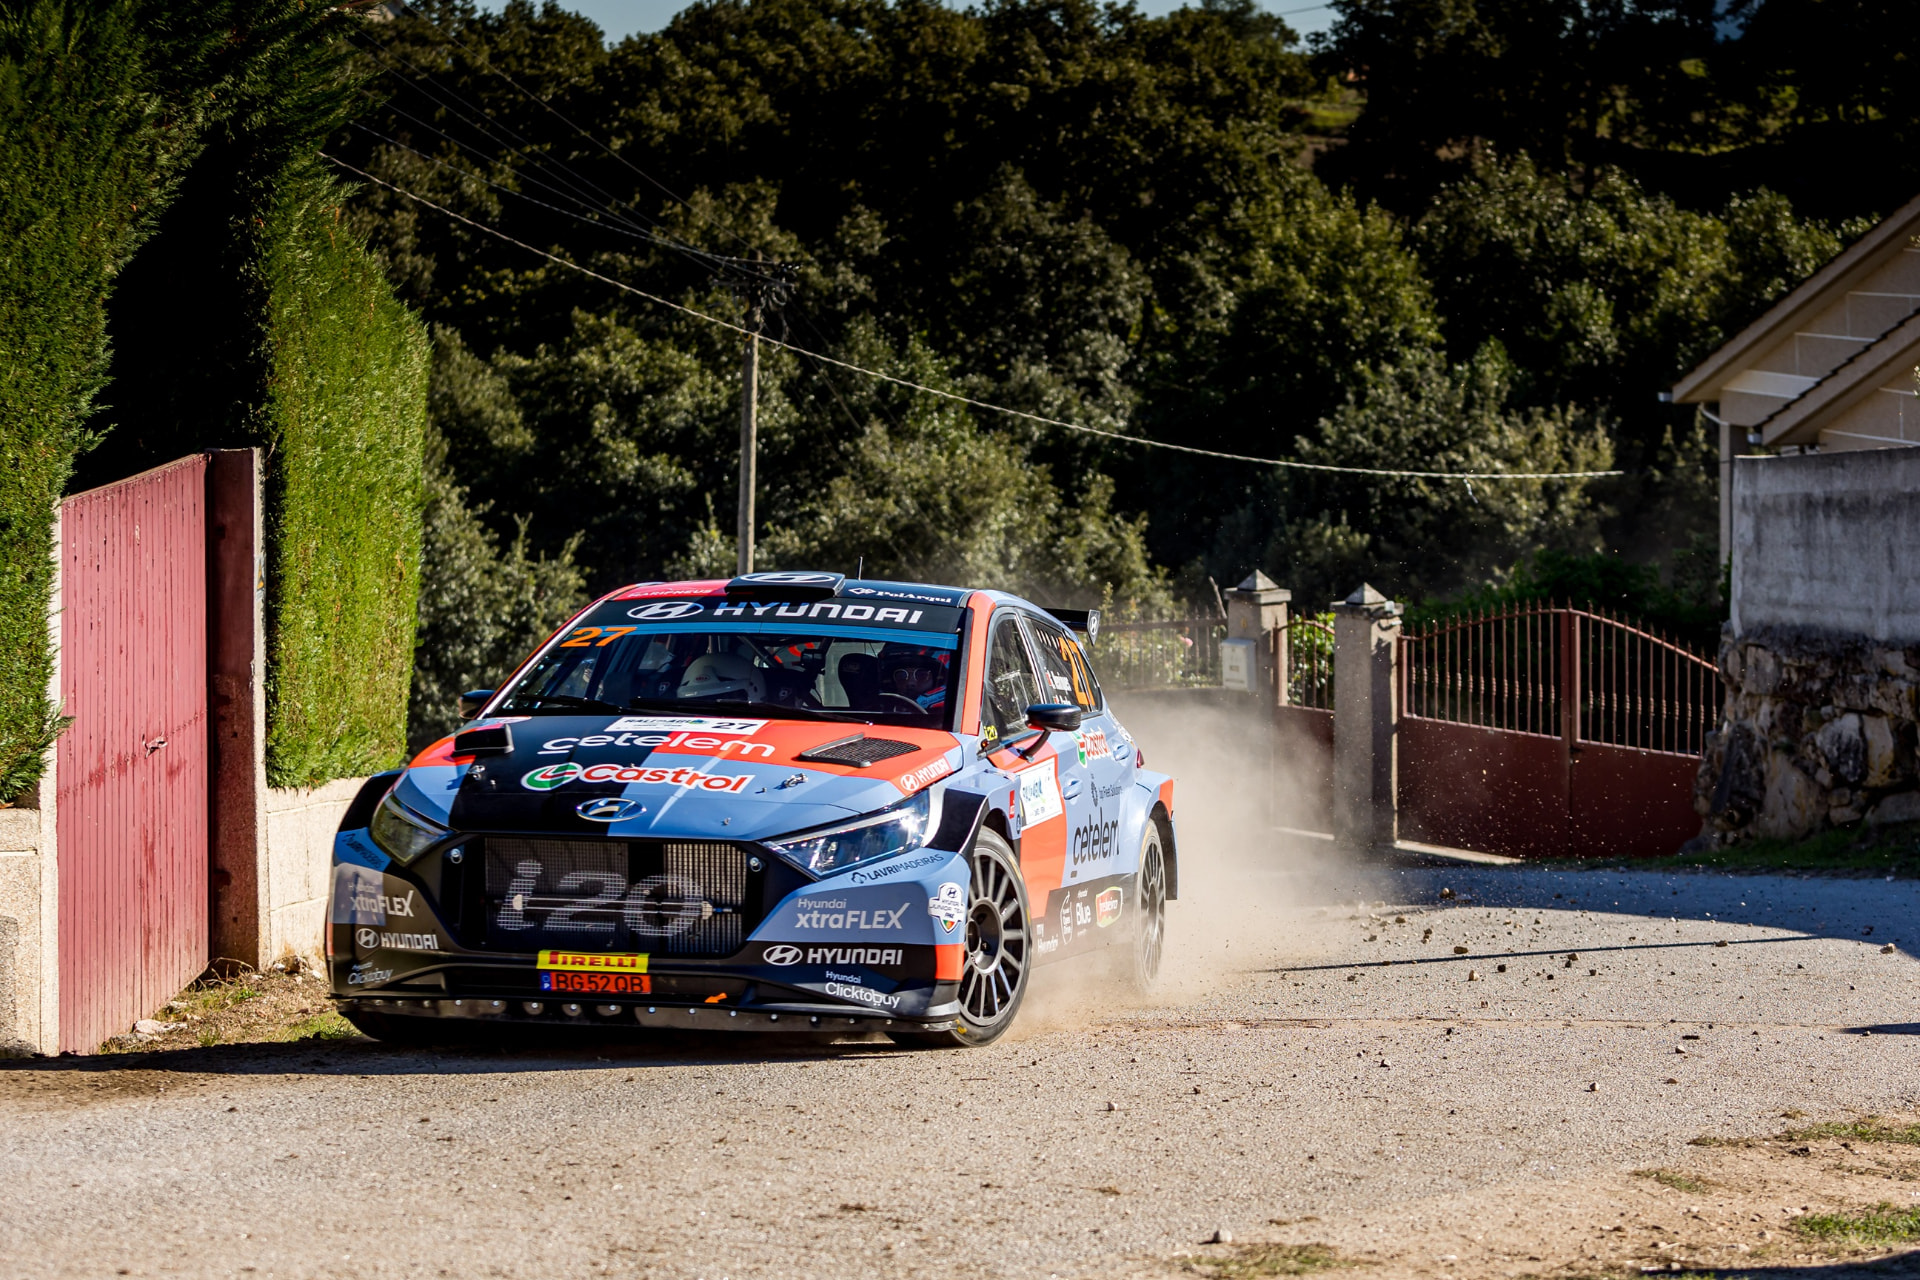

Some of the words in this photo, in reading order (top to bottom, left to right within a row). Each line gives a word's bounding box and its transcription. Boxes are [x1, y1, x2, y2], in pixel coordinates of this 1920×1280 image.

[713, 601, 923, 624] HYUNDAI
[558, 626, 637, 648] 27
[711, 721, 758, 731] 27
[984, 725, 998, 740] i20
[538, 733, 776, 757] cetelem
[582, 764, 750, 792] Castrol
[914, 757, 951, 783] HYUNDAI
[1073, 807, 1119, 866] cetelem
[868, 853, 944, 881] LAVRIMADEIRAS
[350, 890, 414, 917] xtraFLEX
[797, 898, 847, 910] Hyundai
[795, 903, 910, 929] xtraFLEX
[381, 932, 439, 950] HYUNDAI
[549, 951, 638, 968] PIRELLI
[807, 948, 902, 965] HYUNDAI
[555, 973, 584, 992] BG
[588, 974, 610, 993] 52
[615, 976, 644, 993] QB
[826, 971, 861, 984] Hyundai
[825, 982, 900, 1008] Clicktobuy
